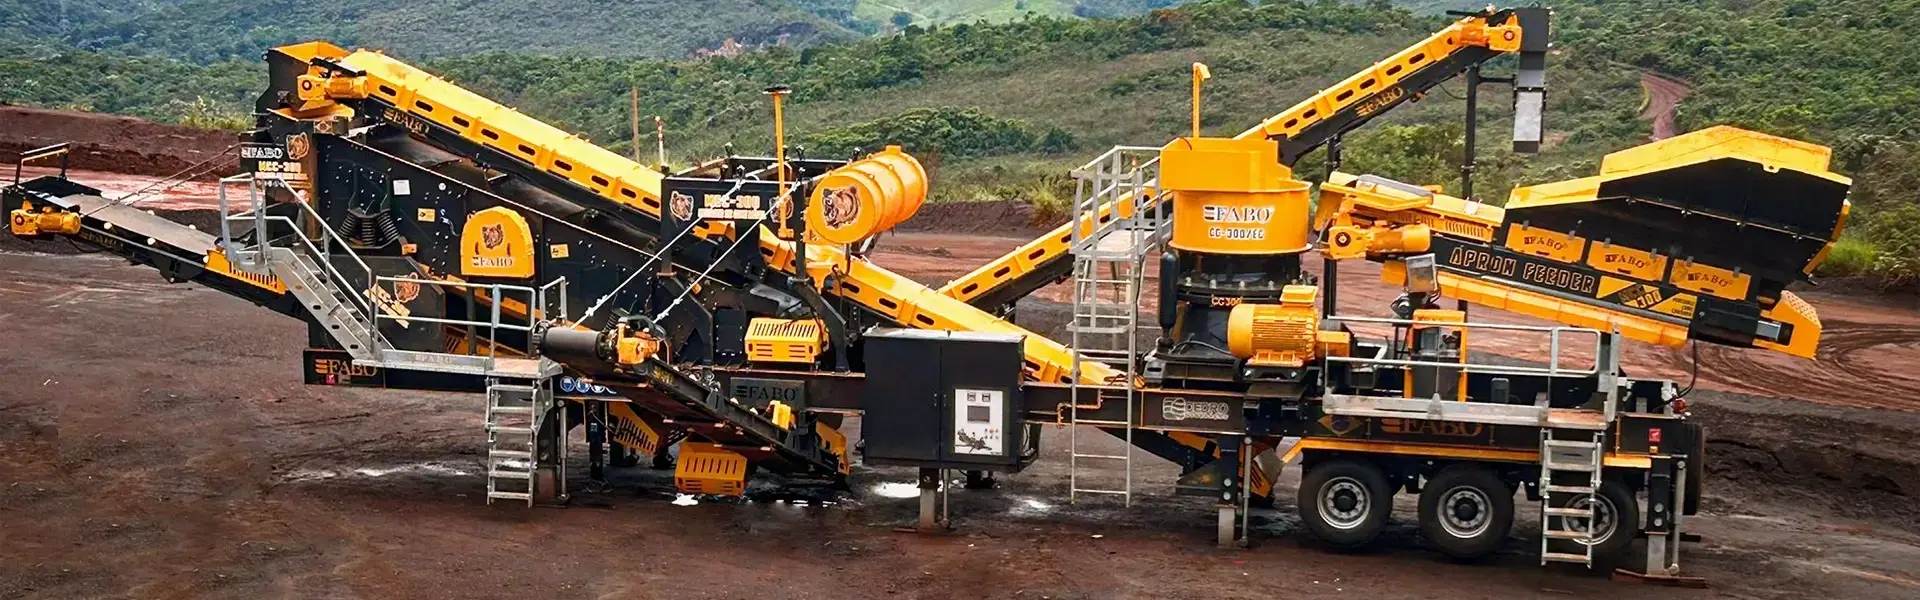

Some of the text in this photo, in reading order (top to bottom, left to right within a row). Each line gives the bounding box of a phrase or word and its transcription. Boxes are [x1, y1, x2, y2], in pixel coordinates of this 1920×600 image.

[1366, 87, 1404, 112] FABO
[393, 112, 430, 137] FABO
[249, 147, 283, 159] FABO
[1217, 206, 1270, 221] FABO
[1529, 236, 1561, 250] FABO
[480, 257, 513, 267] FABO
[1608, 254, 1644, 268] FABO
[1523, 262, 1595, 293] FEEDER
[1695, 272, 1728, 287] FABO
[328, 359, 378, 377] FABO
[749, 386, 796, 401] FABO
[1403, 418, 1483, 437] FABO
